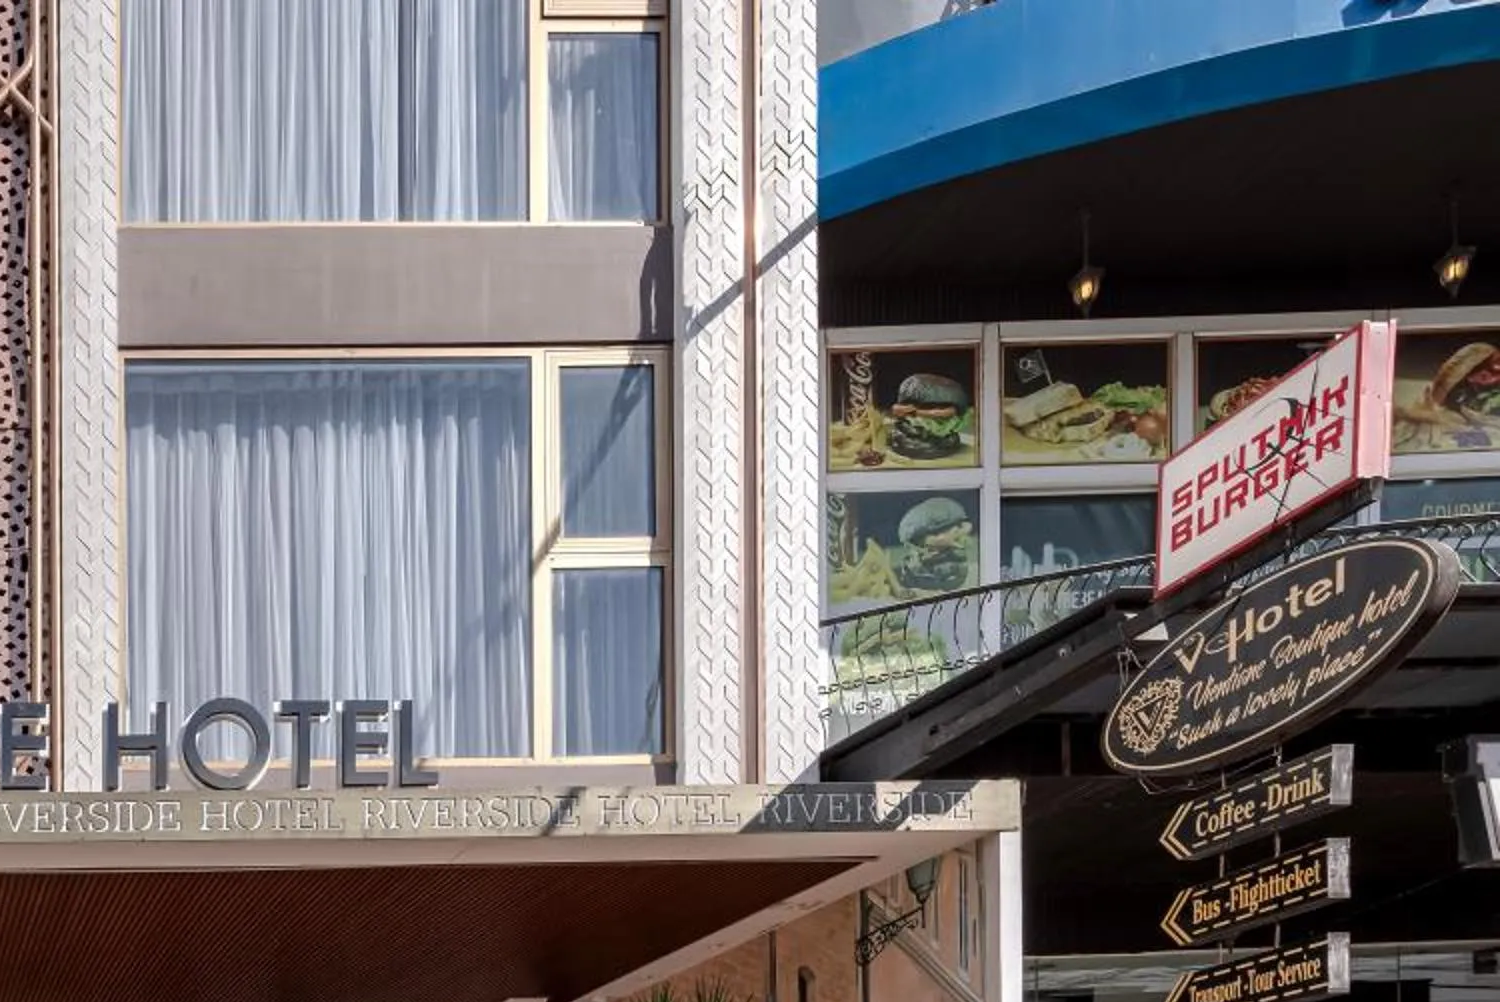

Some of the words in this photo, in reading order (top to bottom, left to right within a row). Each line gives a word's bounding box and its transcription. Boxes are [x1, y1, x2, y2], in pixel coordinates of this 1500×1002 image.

[1171, 374, 1349, 517] SPUTNIK
[1171, 416, 1345, 552] BURGER
[1172, 631, 1205, 676] V
[1203, 557, 1346, 664] Hotel
[1356, 569, 1420, 629] hotel
[1224, 711, 1240, 729] a
[1241, 672, 1302, 721] lovely
[100, 697, 440, 791] HOTEL
[199, 797, 346, 832] HOTEL
[362, 795, 580, 830] RIVERSIDE
[597, 792, 742, 827] HOTEL
[757, 790, 974, 825] RIVERSIDE
[1194, 798, 1256, 837] Coffee
[1192, 896, 1222, 925] Bus
[1277, 953, 1322, 987] Service
